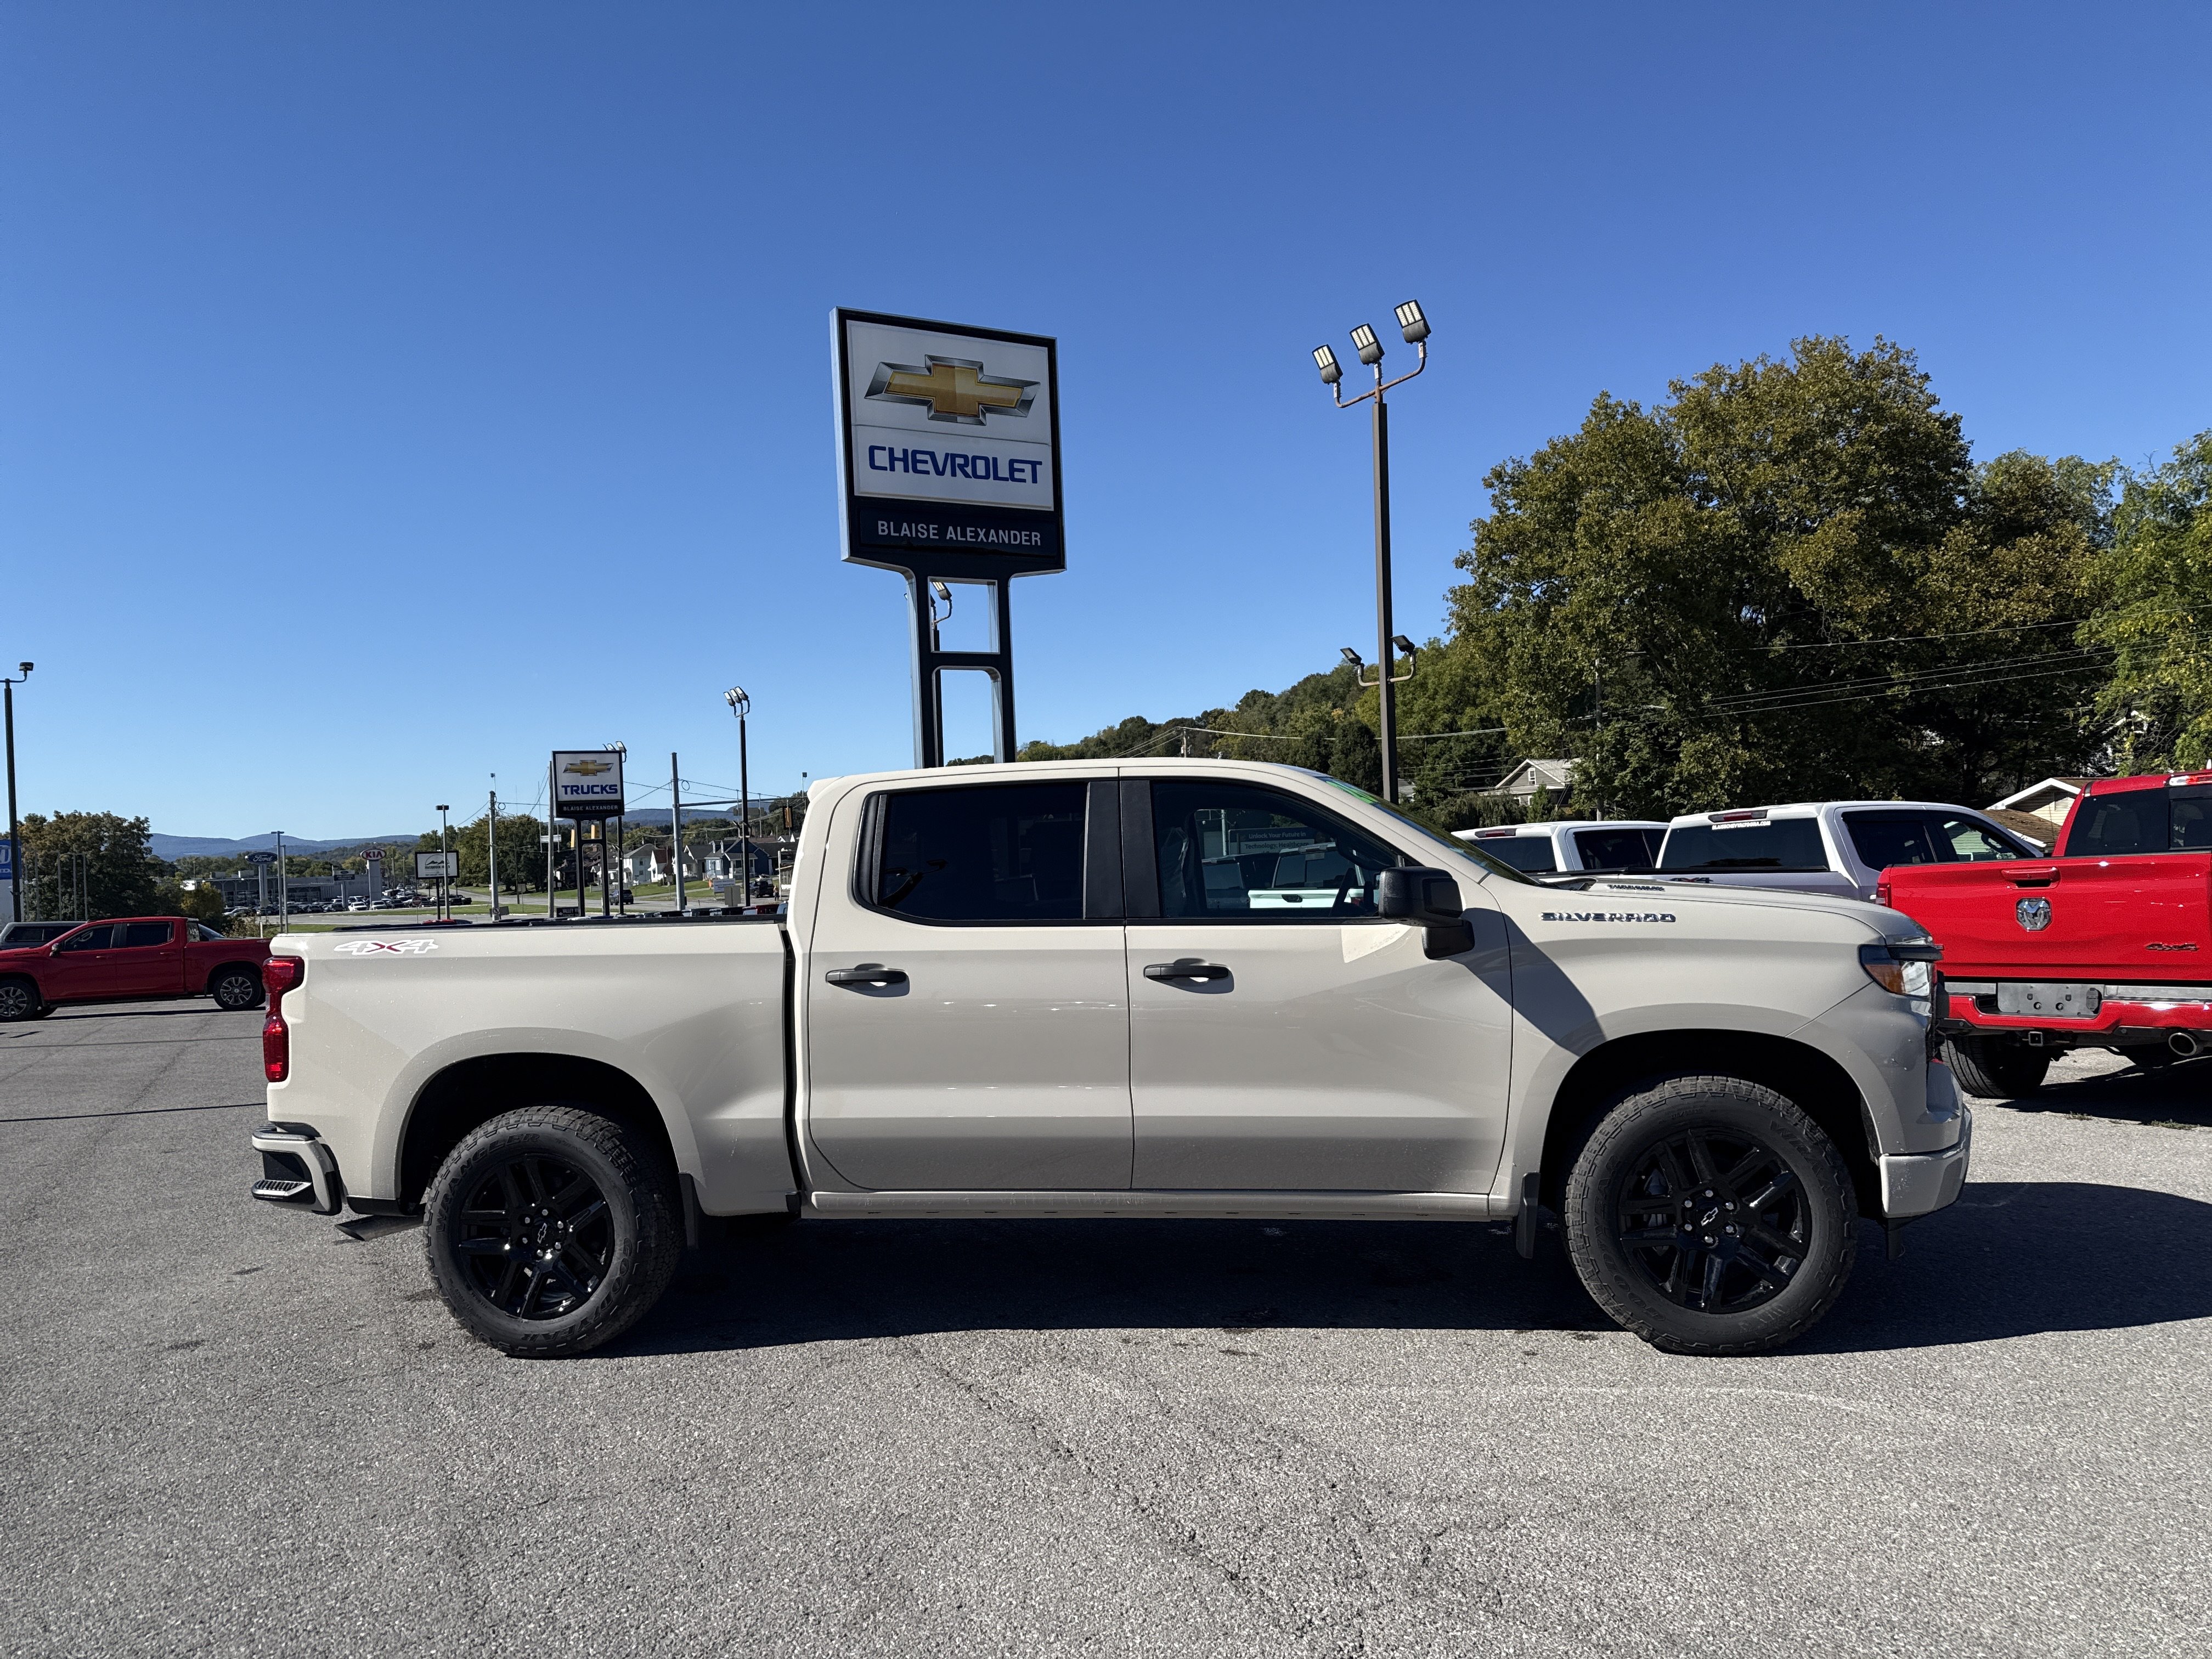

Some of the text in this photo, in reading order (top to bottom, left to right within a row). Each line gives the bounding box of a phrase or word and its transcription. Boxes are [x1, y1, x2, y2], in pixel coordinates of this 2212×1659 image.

[868, 445, 1042, 484] CHEVROLET
[878, 521, 1041, 546] BLAISE ALEXANDER
[561, 784, 618, 795] TRUCKS
[1539, 912, 1676, 922] SILVERADO
[436, 1133, 540, 1233] WRANGLER
[1594, 1154, 1666, 1322] GOODYEAR
[521, 1237, 633, 1342] GOODYEAR
